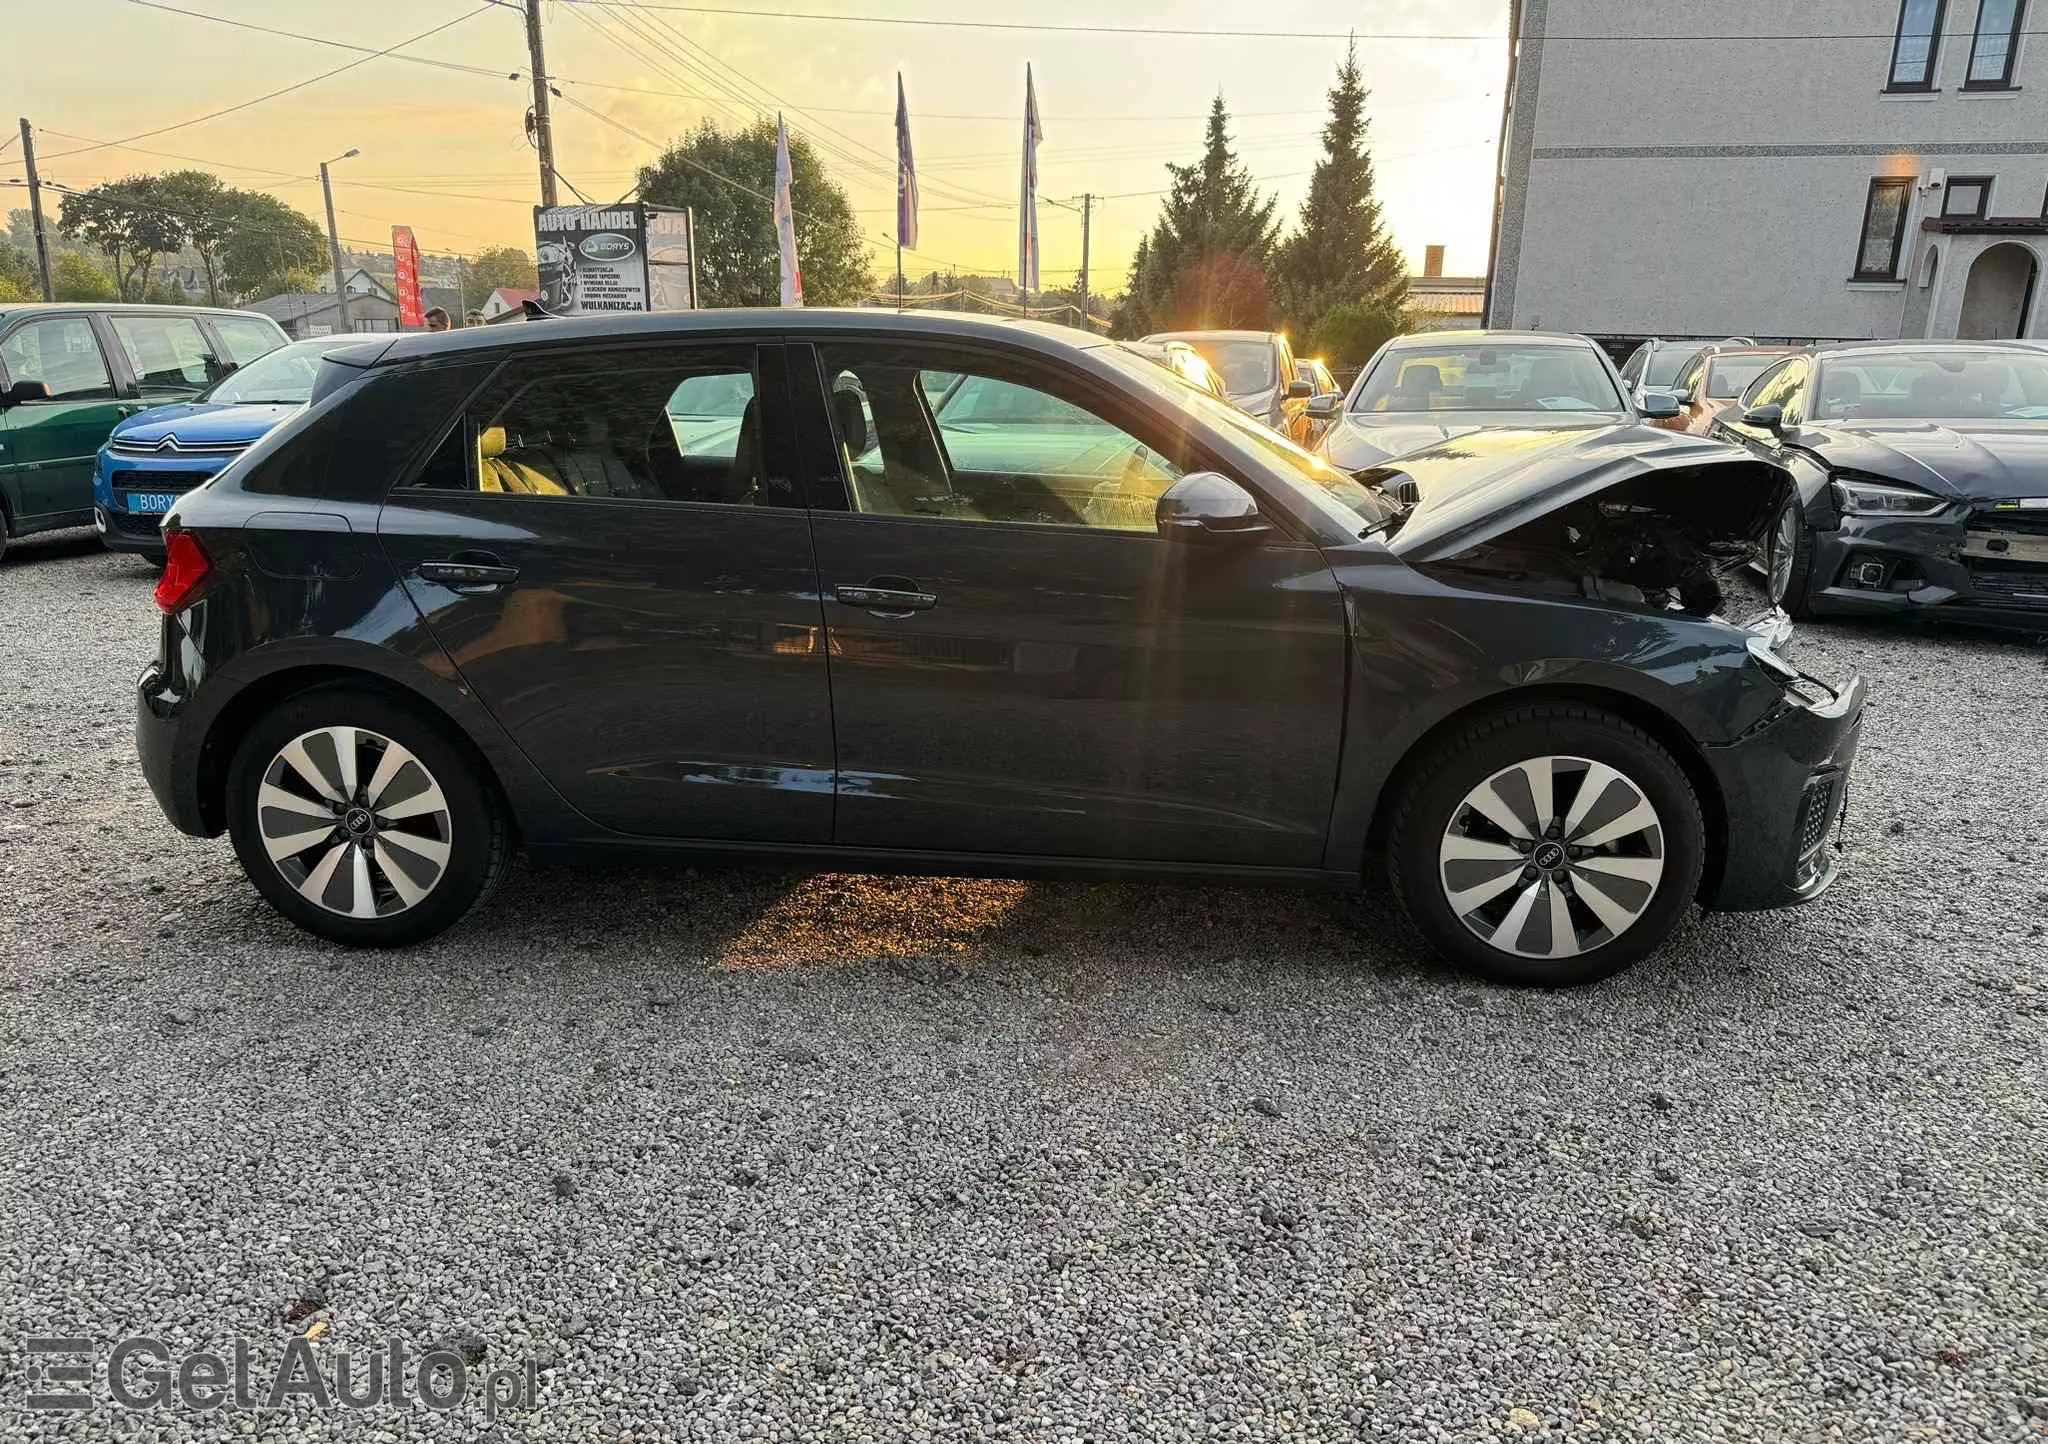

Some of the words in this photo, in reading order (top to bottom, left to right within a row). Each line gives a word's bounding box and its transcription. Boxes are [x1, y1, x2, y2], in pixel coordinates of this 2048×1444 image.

[538, 213, 576, 232] AUTO
[580, 211, 638, 230] HANDEL
[600, 242, 630, 251] BORYS
[581, 301, 643, 311] WULKANIZACJA
[140, 494, 180, 511] BORY
